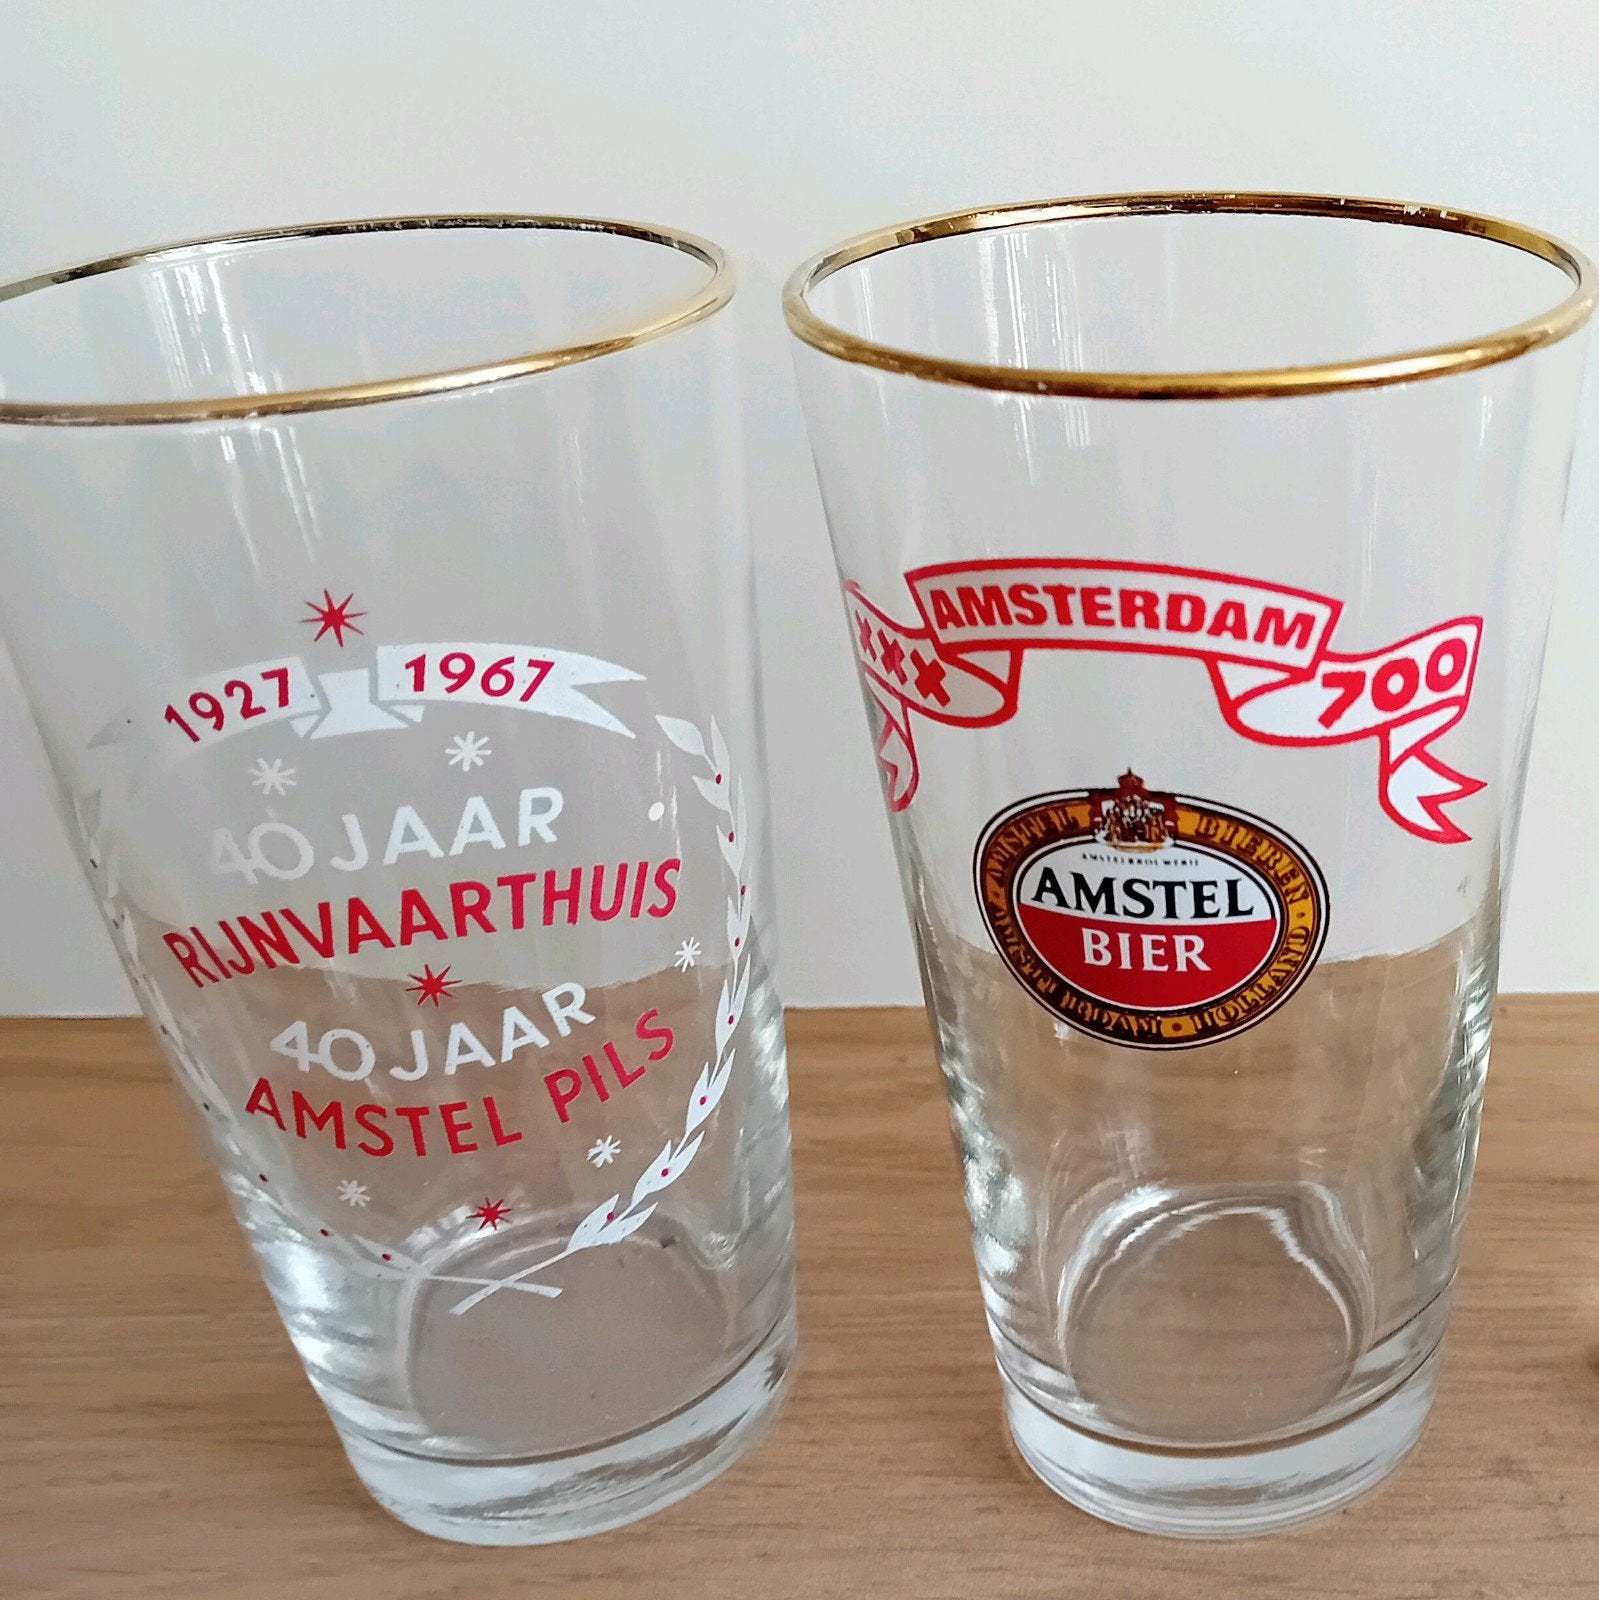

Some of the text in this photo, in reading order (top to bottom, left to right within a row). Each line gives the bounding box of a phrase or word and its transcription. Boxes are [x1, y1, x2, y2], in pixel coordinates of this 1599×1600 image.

[929, 584, 1319, 650] AMSTERDAM
[164, 652, 555, 743] 1927 1967
[1322, 636, 1466, 730] 700
[209, 786, 564, 885] 40 JAAR
[163, 858, 681, 988] RIJNVAARTHUIS
[1031, 866, 1254, 920] AMSTEL
[1081, 927, 1212, 973] BIER
[1190, 926, 1311, 1032] HOLLAND
[271, 981, 597, 1082] 40 JAAR
[245, 1008, 675, 1157] AMSTEL PILS
